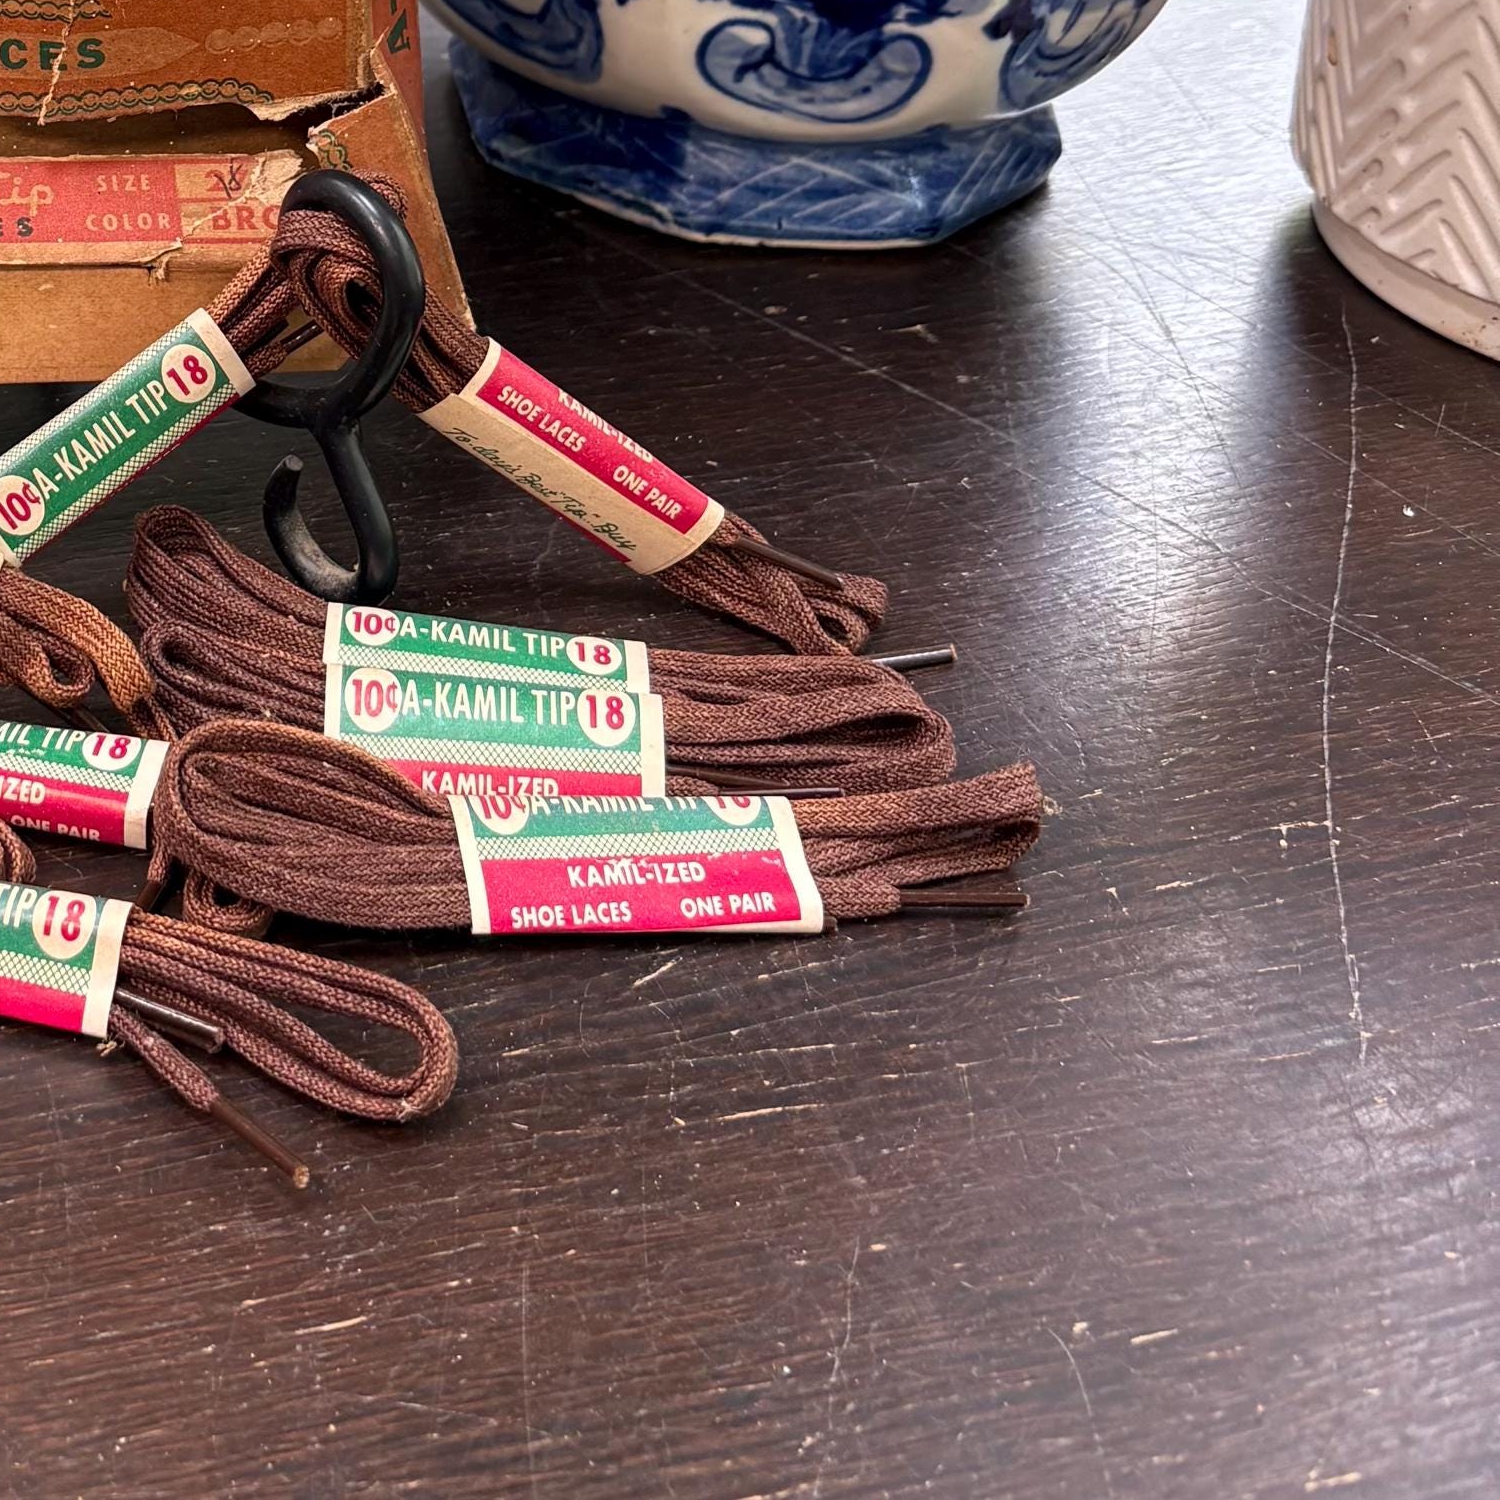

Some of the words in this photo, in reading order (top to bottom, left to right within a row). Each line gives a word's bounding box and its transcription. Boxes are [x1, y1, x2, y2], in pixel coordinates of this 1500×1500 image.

[96, 174, 151, 192] SIZE
[86, 212, 171, 231] COLOR
[32, 411, 136, 500] A-KAMIL
[125, 379, 168, 425] TIP
[166, 355, 208, 397] 18
[497, 385, 542, 423] SHOE
[539, 412, 587, 453] LACES
[612, 465, 648, 496] ONE
[644, 488, 683, 520] PAIR
[352, 611, 397, 636] 10¢
[400, 616, 516, 653] A-KAMIL
[523, 632, 566, 658] TIP
[574, 641, 612, 665] 18
[352, 679, 398, 718] 10¢
[402, 681, 525, 725] A-KAMIL
[531, 689, 577, 726] TIP
[586, 694, 625, 731] 18
[41, 726, 84, 752] TIP
[91, 734, 132, 759] 18
[421, 770, 559, 797] KAMIL-IZED
[57, 823, 101, 842] PAIR
[567, 861, 707, 888] KAMIL-IZED
[42, 895, 86, 943] 18
[511, 904, 565, 929] SHOE
[571, 900, 633, 926] LACES
[680, 894, 723, 918] ONE
[729, 891, 777, 914] PAIR
